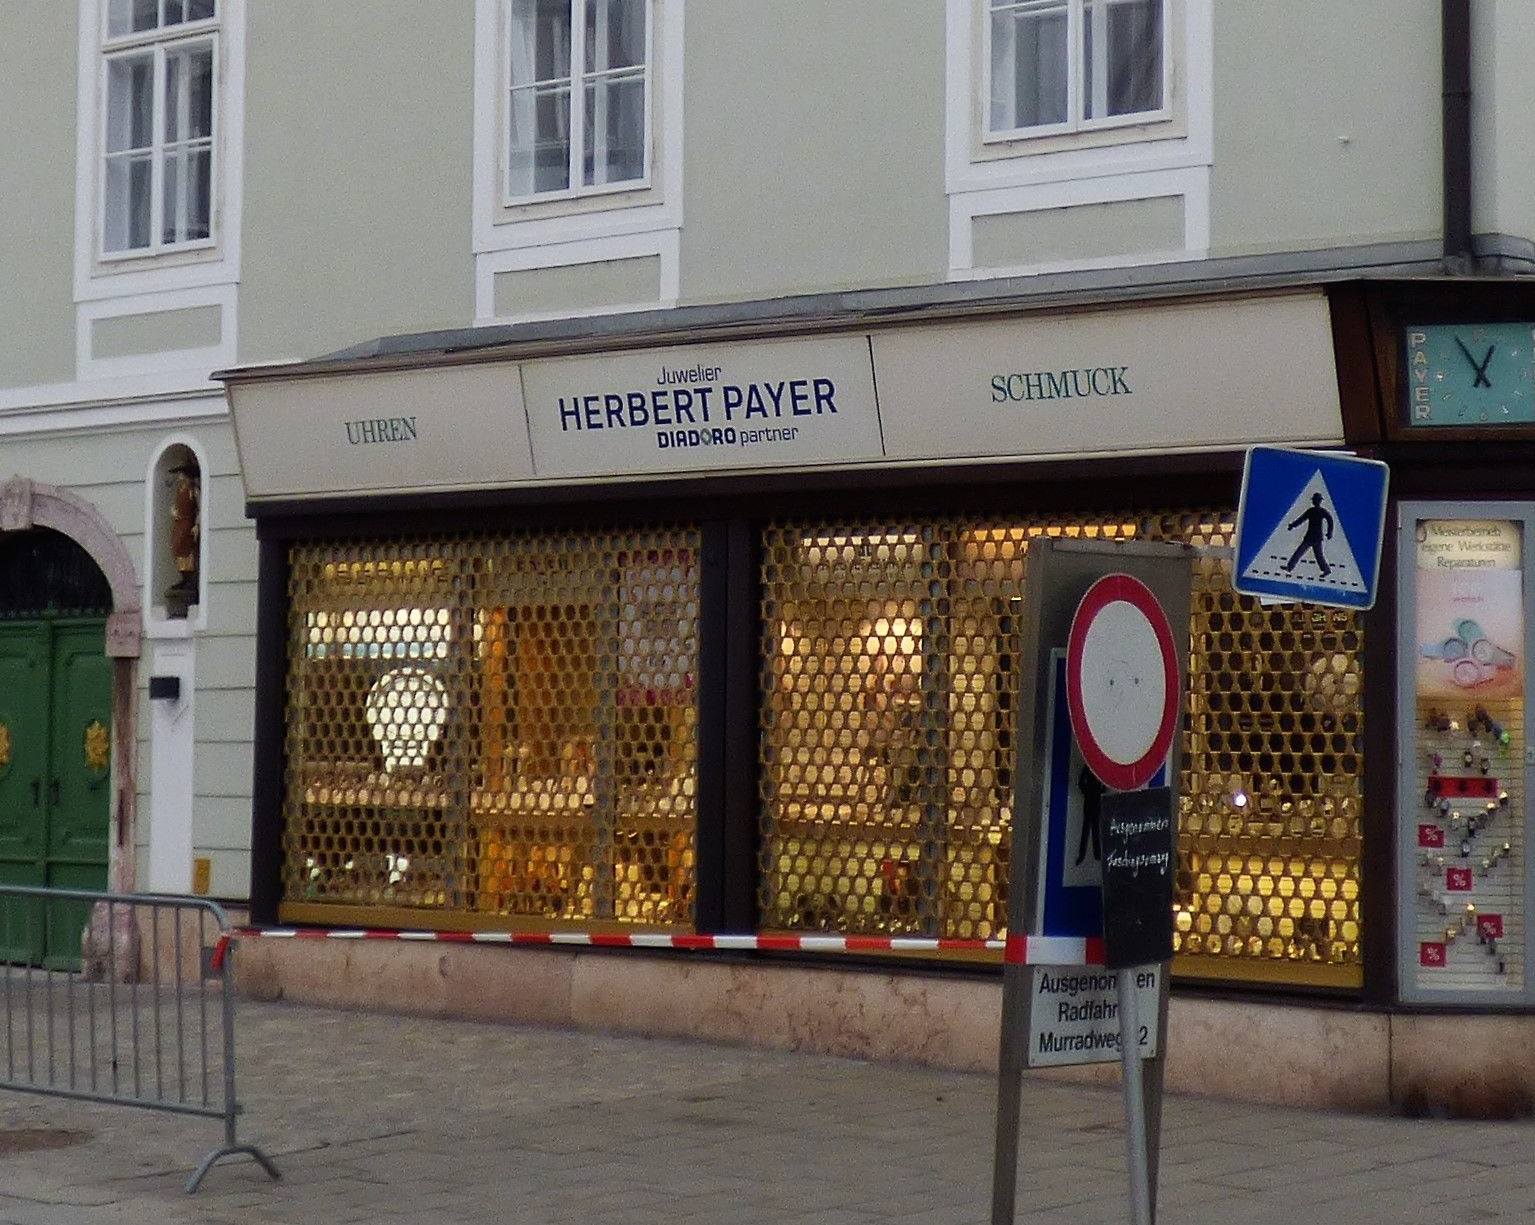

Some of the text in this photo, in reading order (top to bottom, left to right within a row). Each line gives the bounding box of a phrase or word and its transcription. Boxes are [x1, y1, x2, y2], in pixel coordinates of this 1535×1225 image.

[657, 365, 722, 386] Juwelier
[991, 366, 1133, 402] SCHMUCK
[1411, 332, 1431, 421] PAYER
[558, 377, 838, 431] HERBERT PAYER
[344, 416, 418, 446] UHREN
[657, 425, 799, 449] DIADORO partner
[1039, 972, 1155, 996] Ausgenomen
[1058, 1000, 1119, 1022] Radfahr
